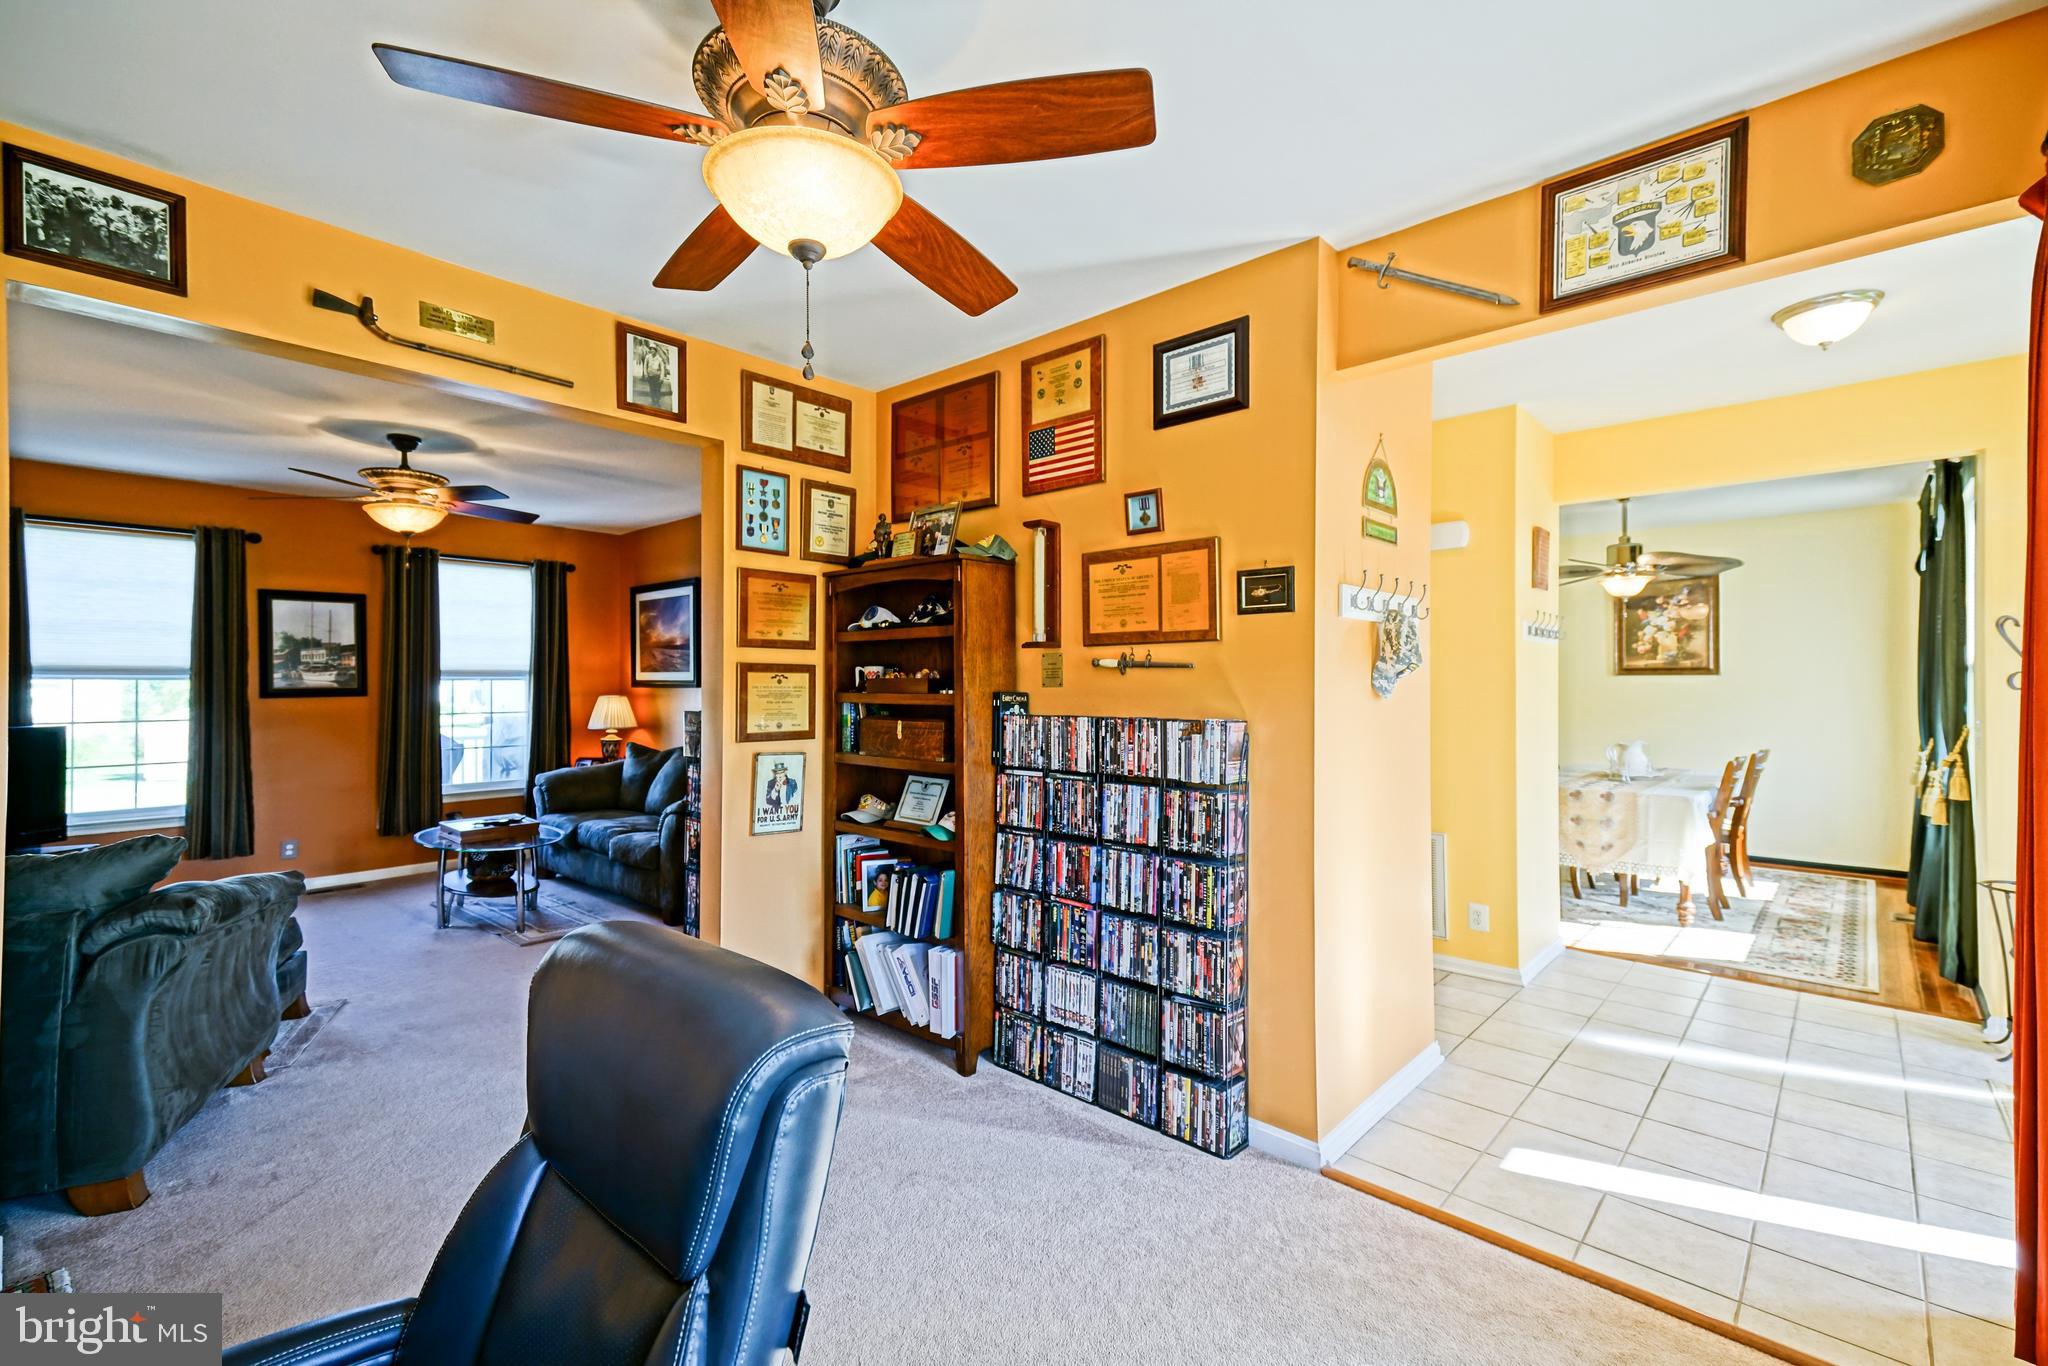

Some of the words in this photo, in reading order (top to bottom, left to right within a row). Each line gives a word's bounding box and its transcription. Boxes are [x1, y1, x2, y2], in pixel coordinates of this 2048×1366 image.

[1615, 204, 1658, 220] AIRBORNE
[762, 806, 783, 816] WANT
[784, 804, 798, 814] YOU
